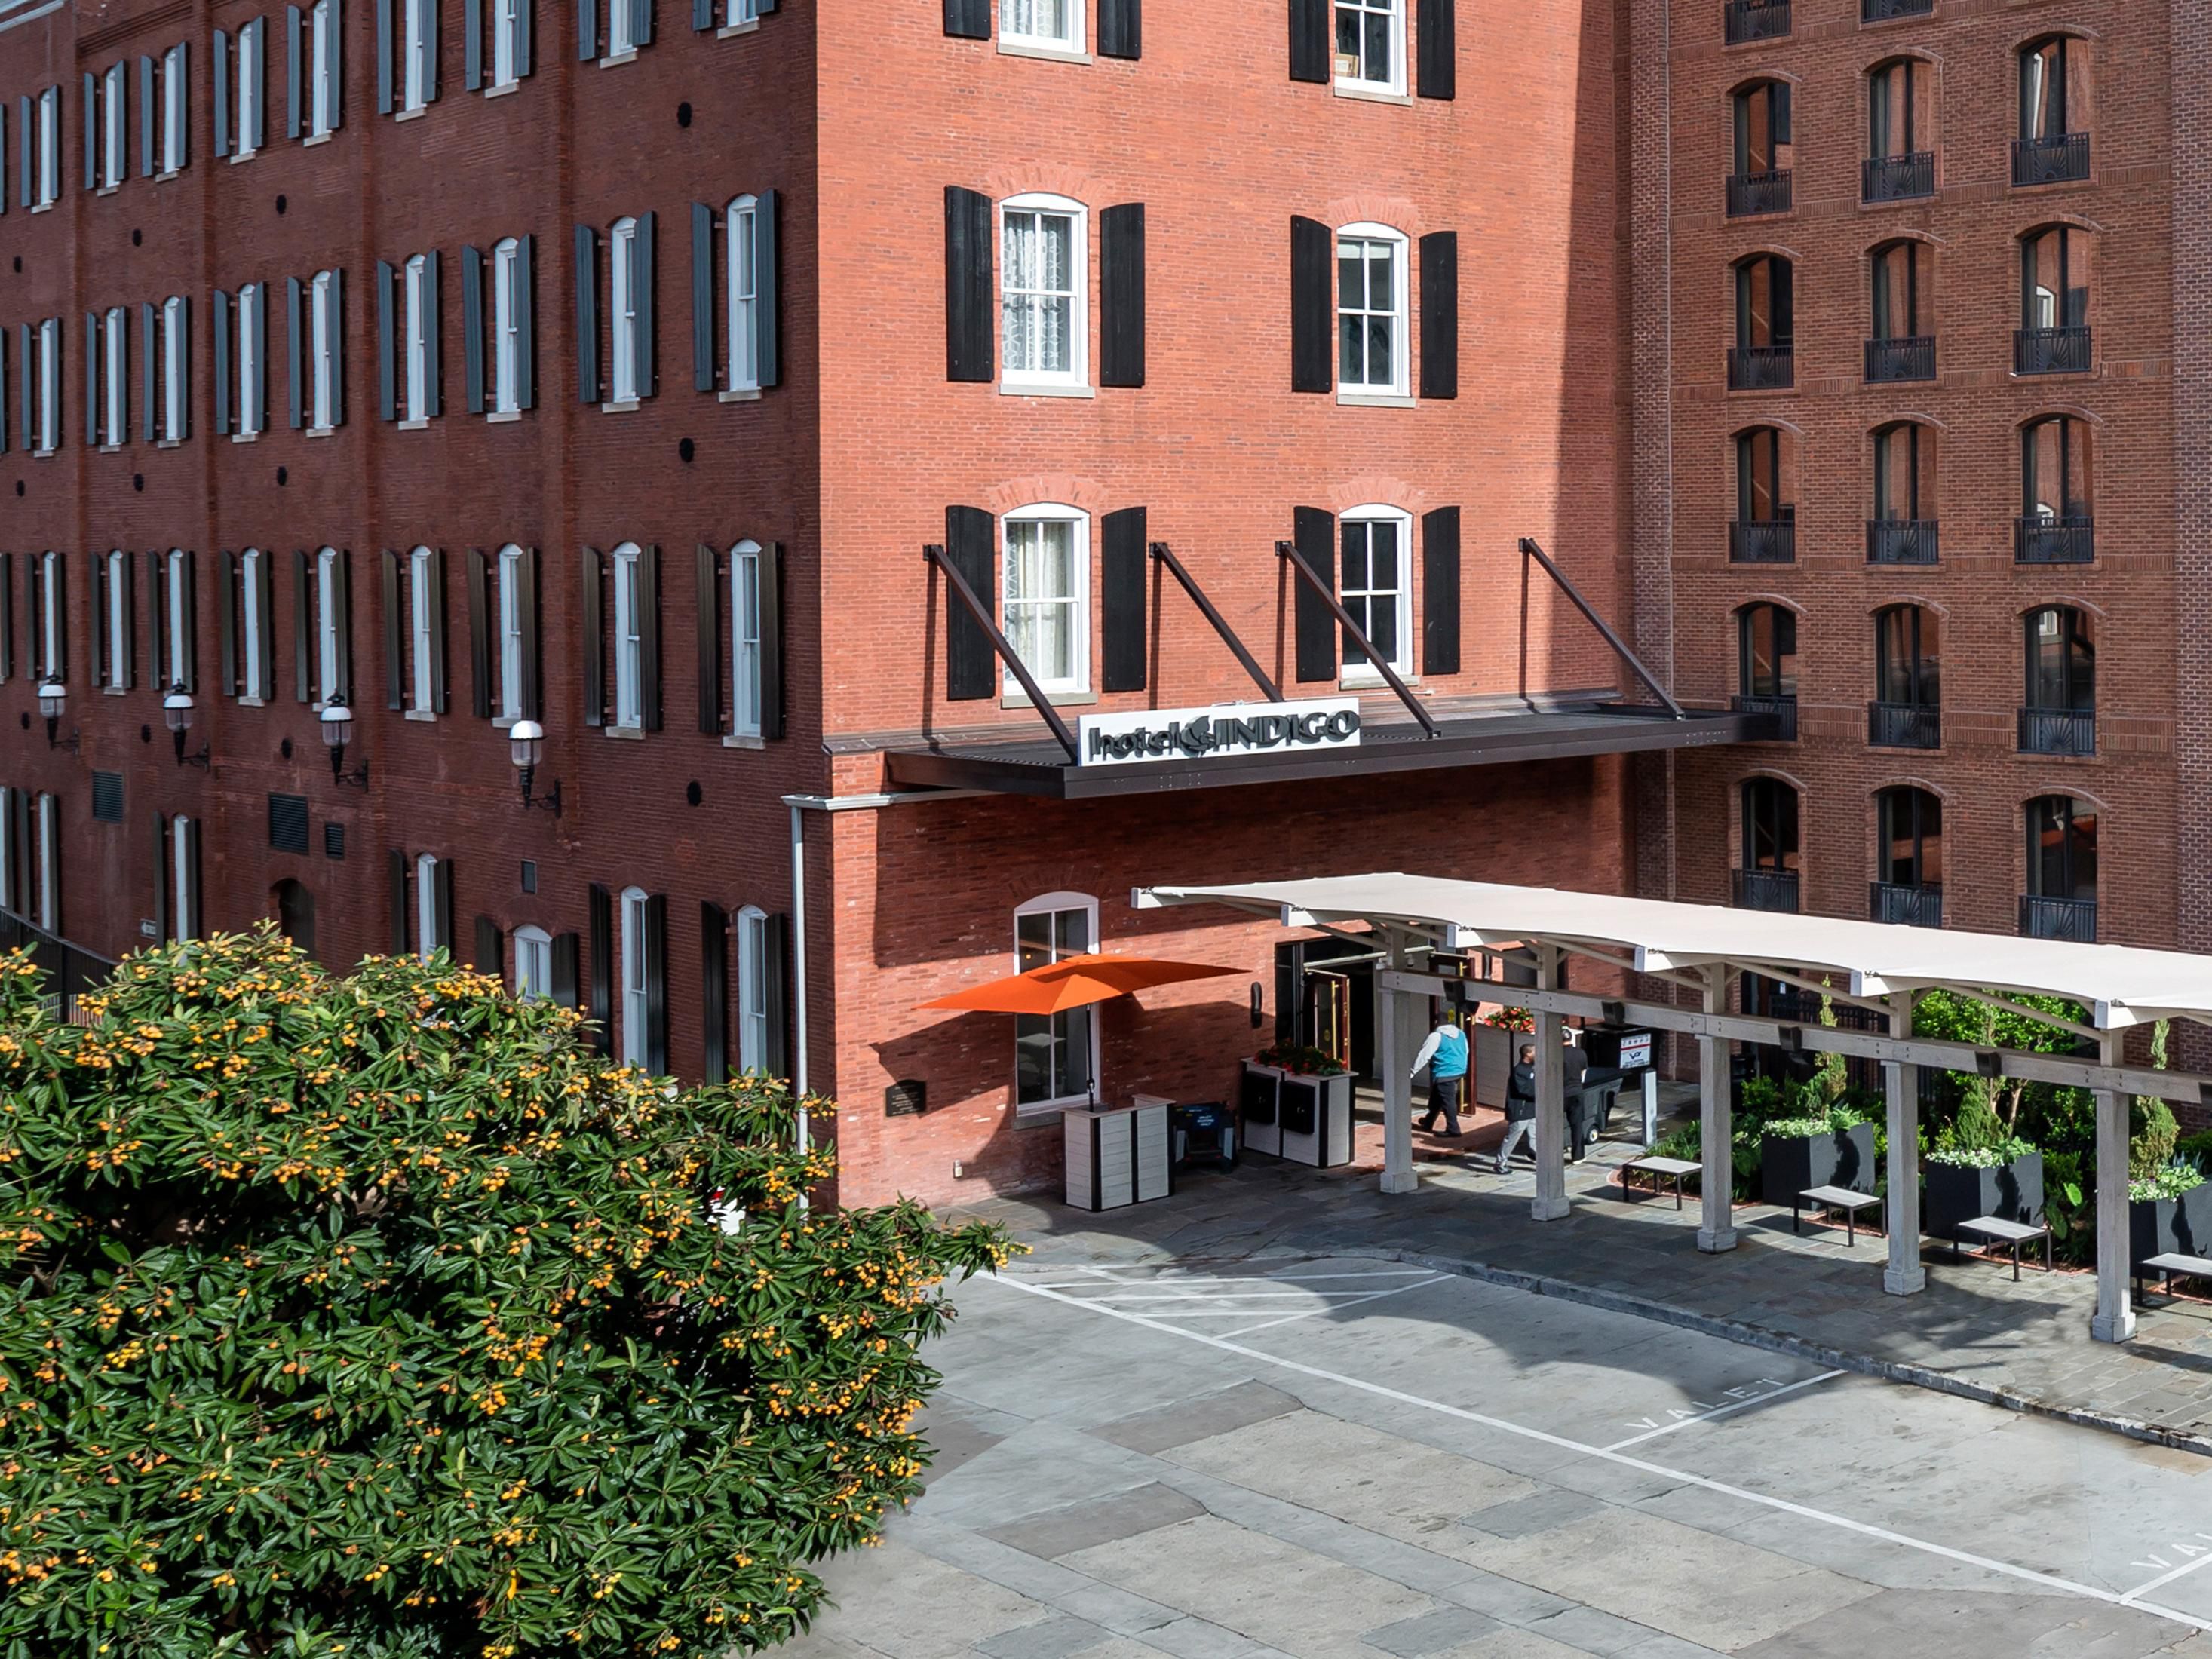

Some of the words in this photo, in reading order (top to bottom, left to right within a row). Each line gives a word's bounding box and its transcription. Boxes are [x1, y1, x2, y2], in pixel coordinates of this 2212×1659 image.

[1088, 721, 1180, 759] hotel
[1213, 710, 1361, 750] INDIGO
[1624, 1377, 1785, 1430] VALET
